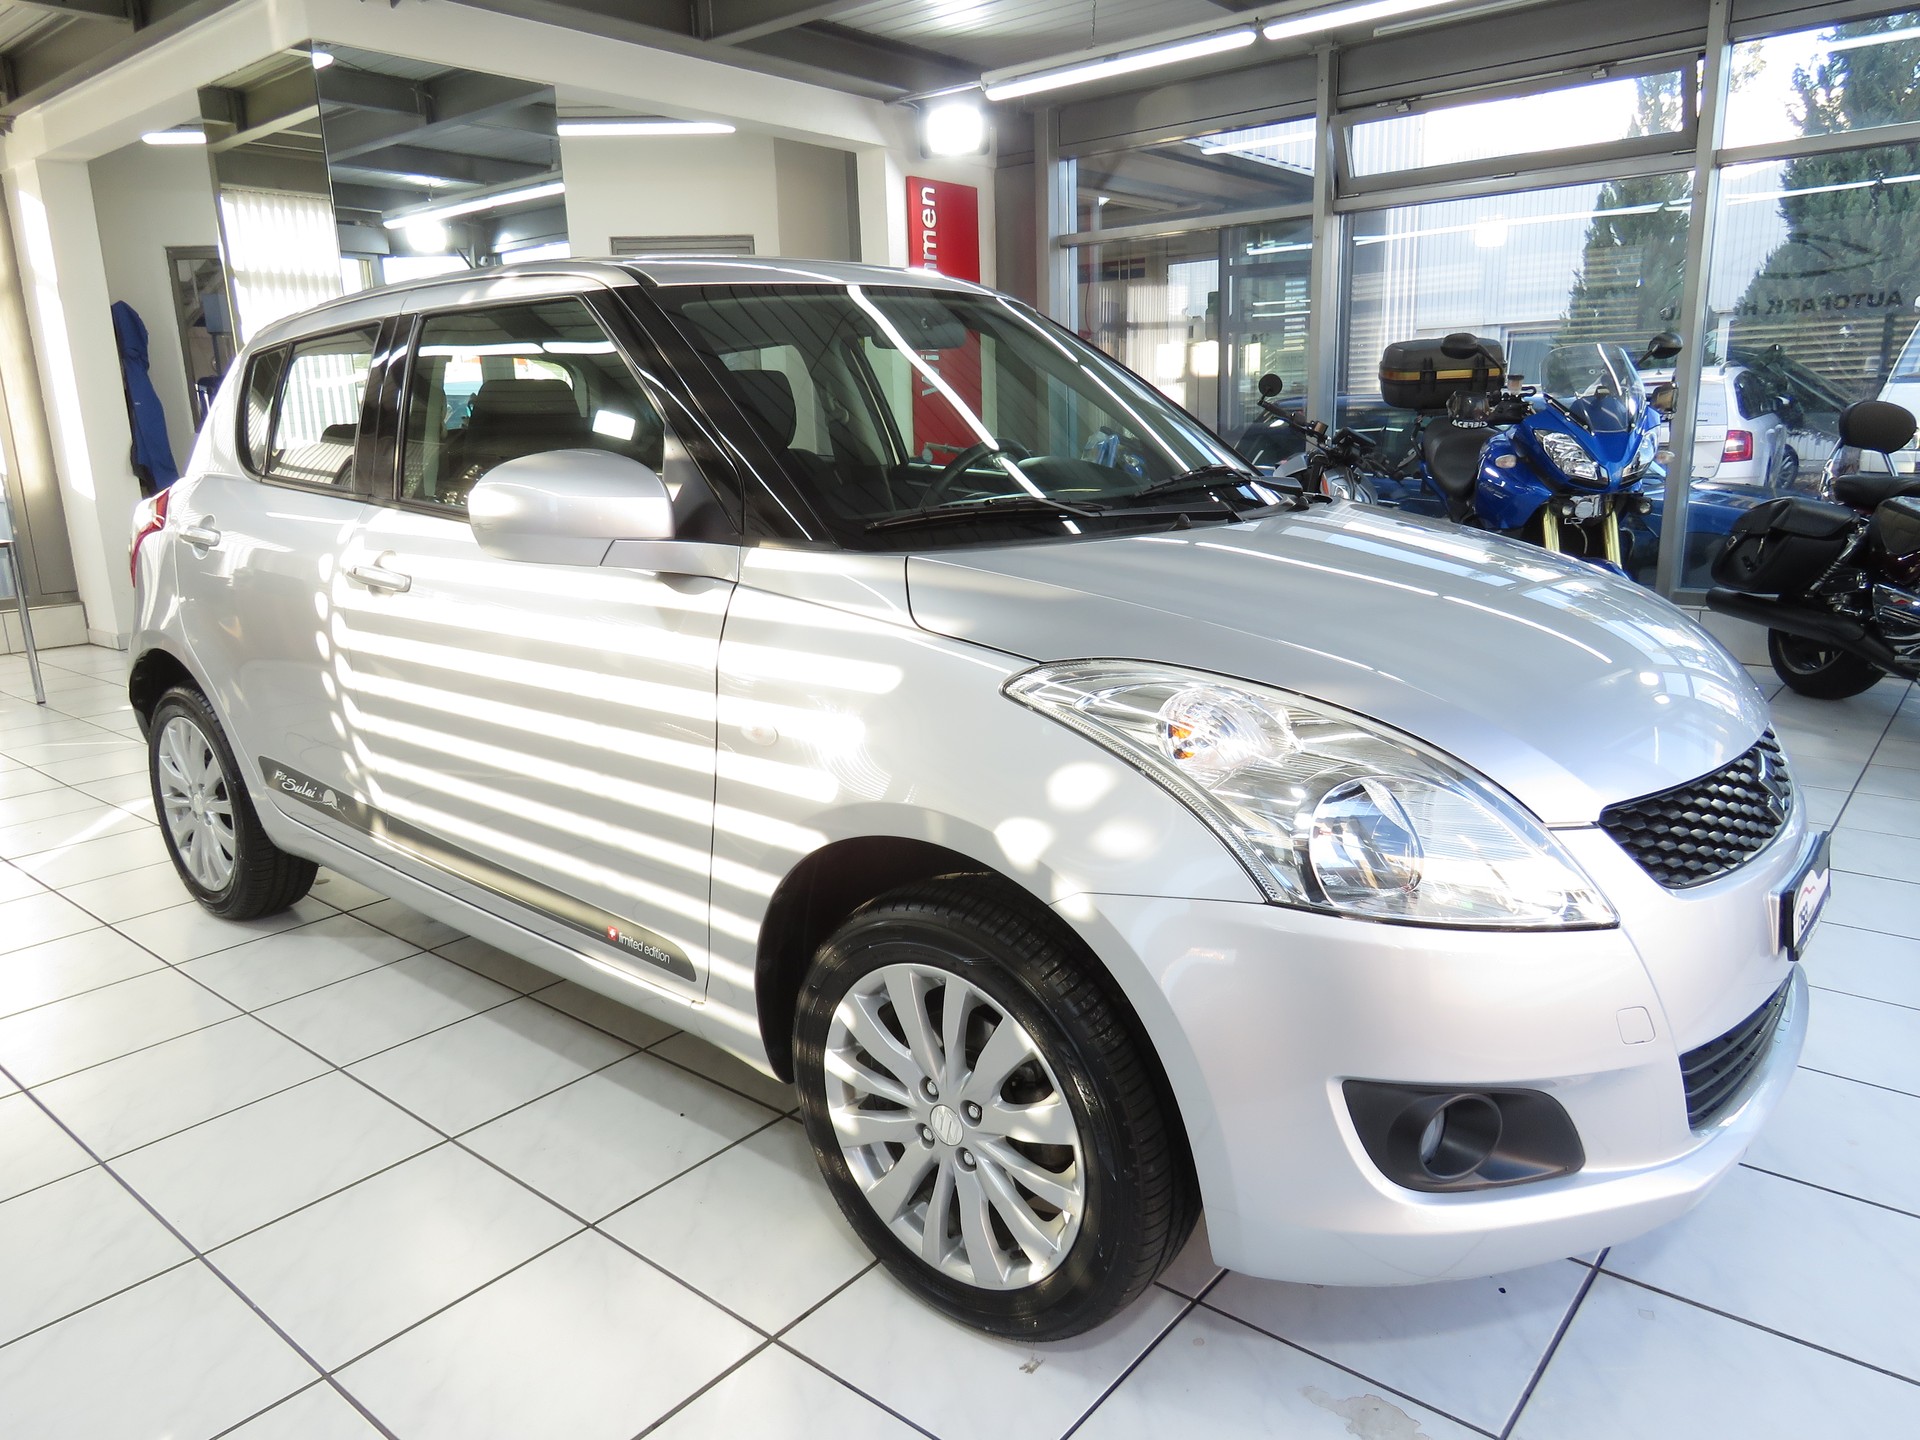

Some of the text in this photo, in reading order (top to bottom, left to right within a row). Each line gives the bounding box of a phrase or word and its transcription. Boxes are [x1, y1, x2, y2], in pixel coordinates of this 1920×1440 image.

[281, 778, 318, 799] Sulai
[618, 932, 670, 964] limited edition
